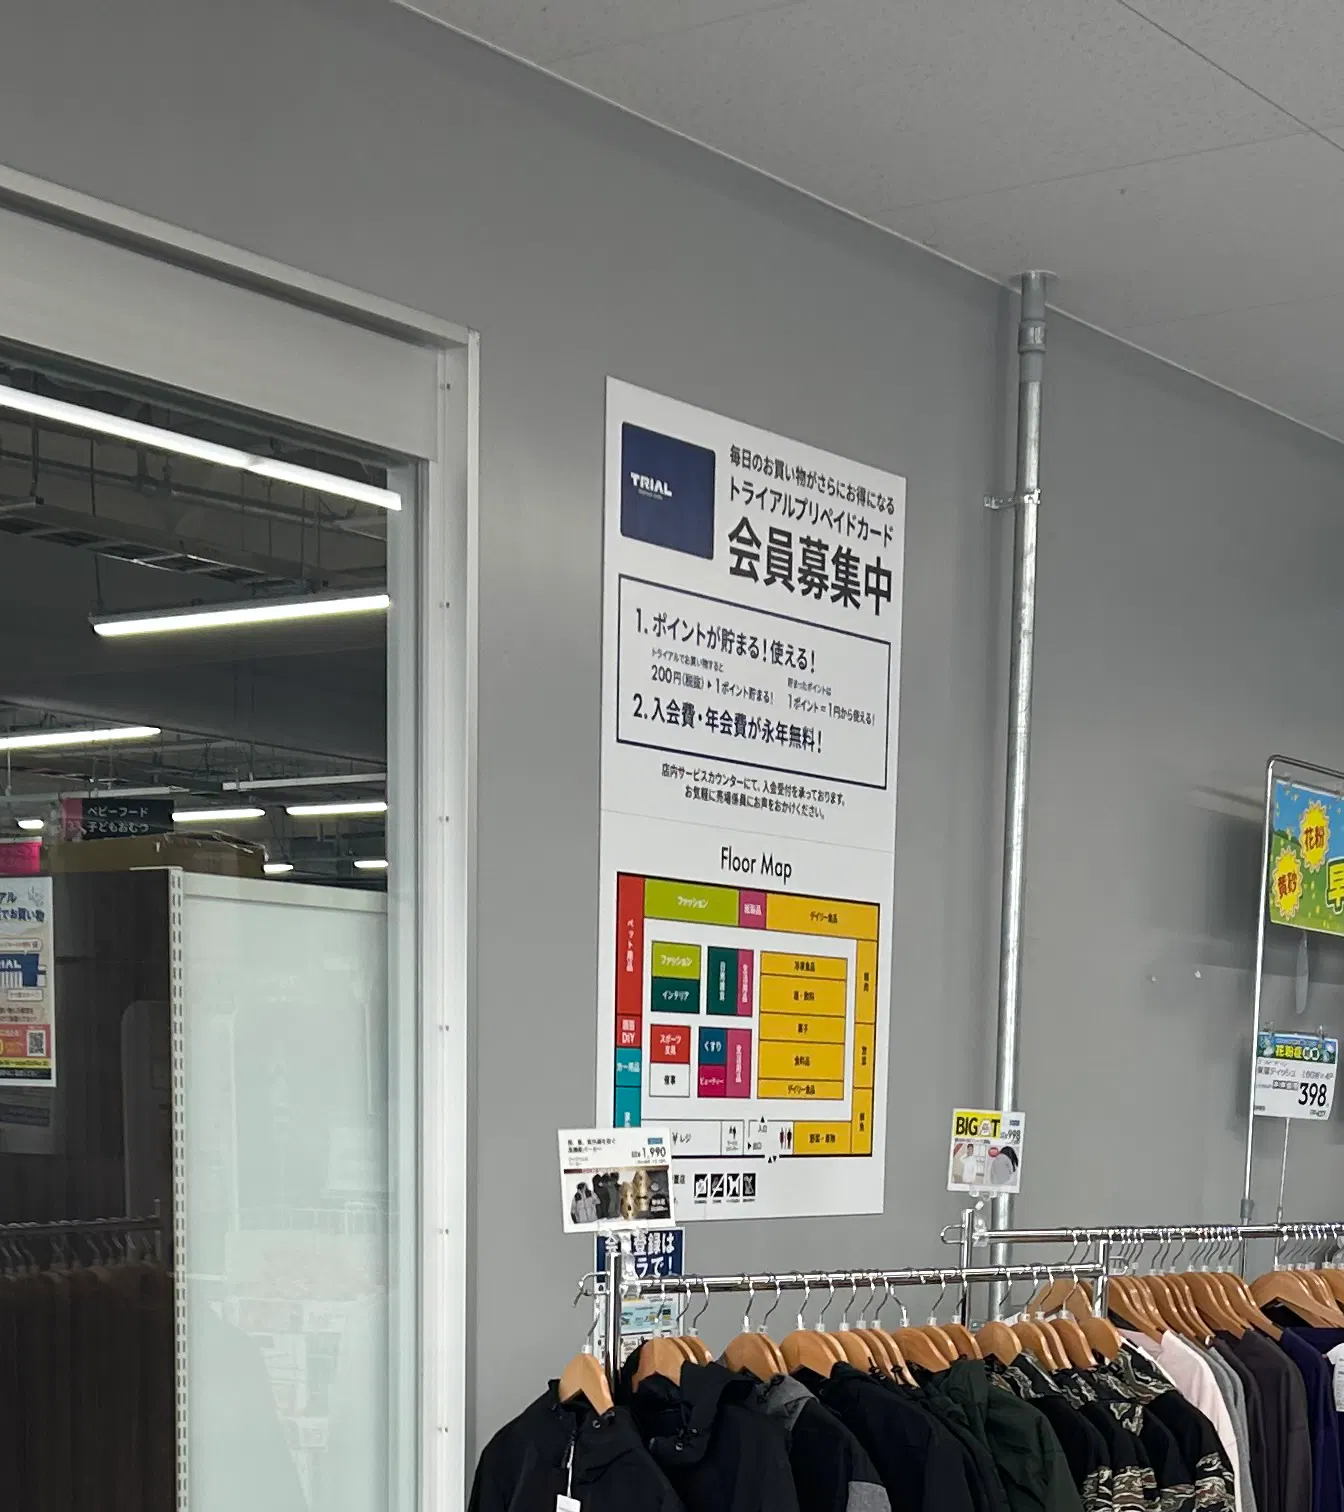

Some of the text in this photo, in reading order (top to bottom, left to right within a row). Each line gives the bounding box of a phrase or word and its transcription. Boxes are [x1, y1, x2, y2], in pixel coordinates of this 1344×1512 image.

[630, 472, 672, 497] TRIAL
[729, 444, 895, 515] 毎日のお買い物がさらにお得になる
[730, 476, 894, 548] トライアルプリペイドカード
[727, 516, 893, 616] 会員募集中
[87, 806, 148, 818] ベビーフード
[720, 846, 793, 885] Floor Map
[1298, 1082, 1328, 1107] 398
[955, 1116, 978, 1136] BIG
[605, 1232, 675, 1256] 会登録は
